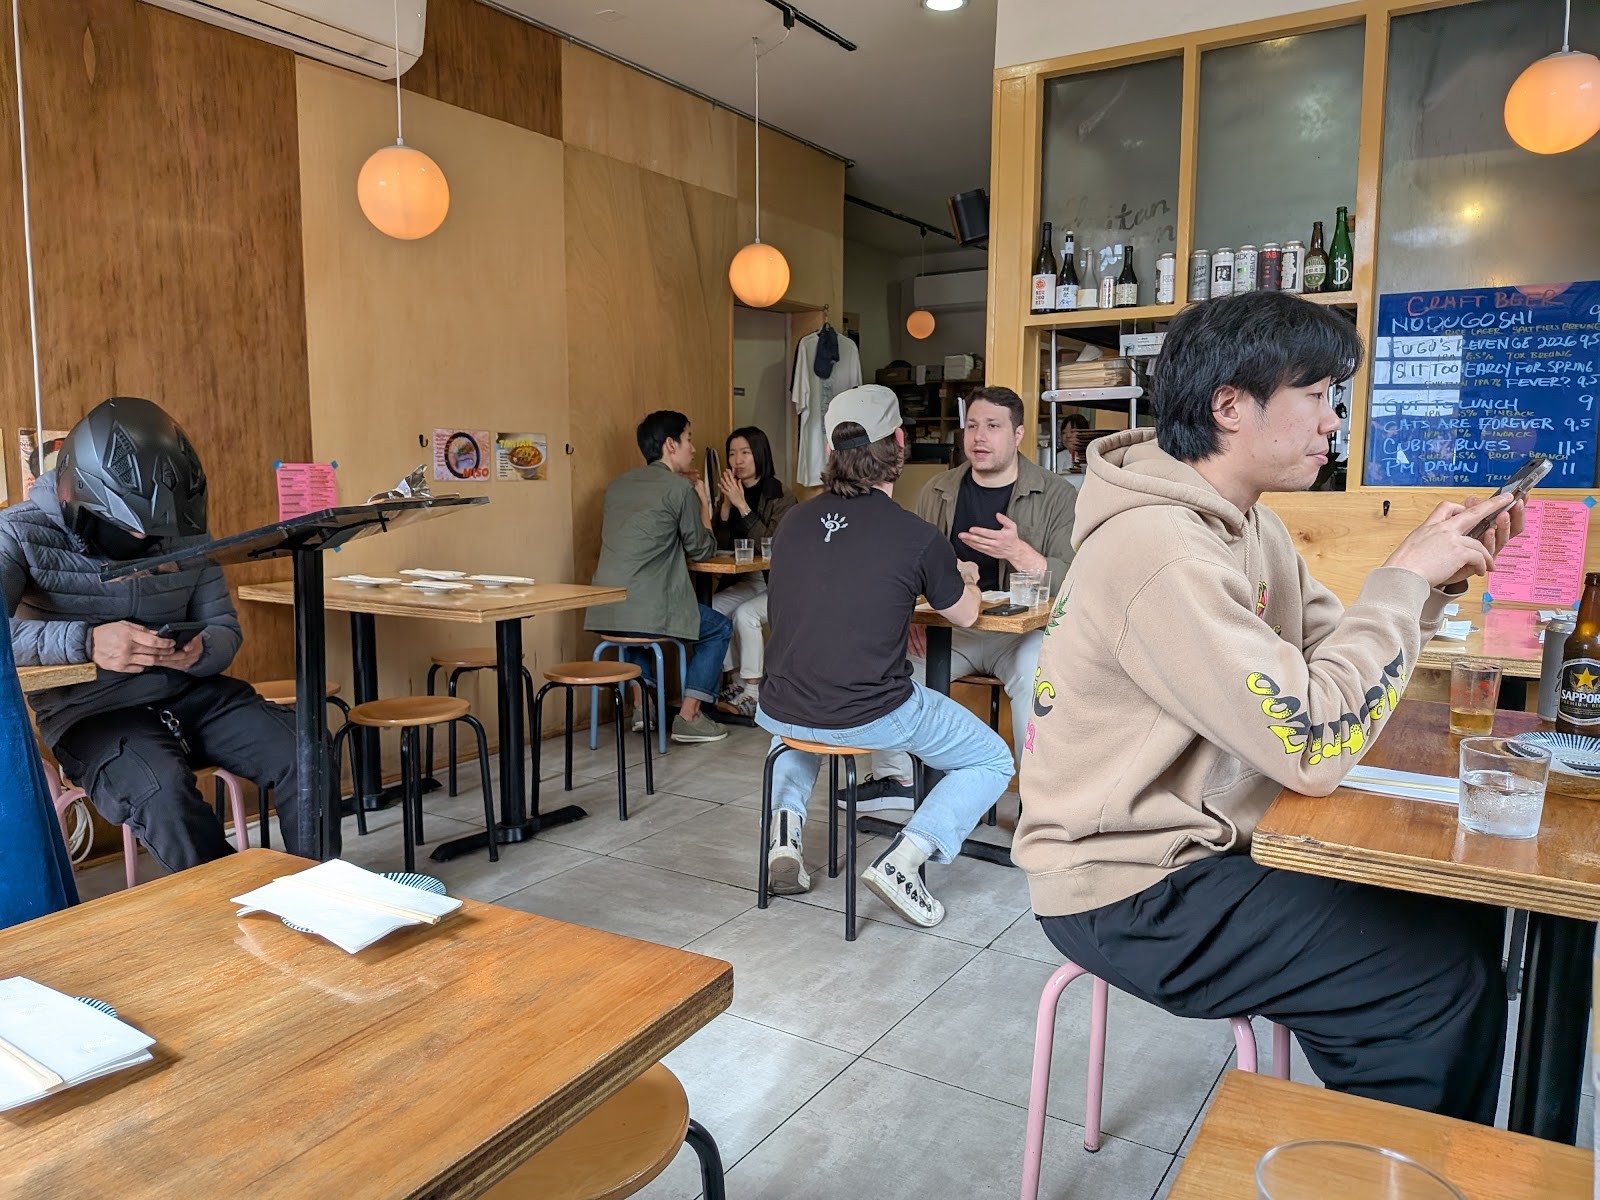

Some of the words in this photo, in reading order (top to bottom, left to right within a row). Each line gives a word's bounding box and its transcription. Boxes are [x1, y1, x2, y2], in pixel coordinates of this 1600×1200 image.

[1495, 289, 1564, 309] BEER
[1471, 327, 1503, 336] LAGER
[1457, 336, 1533, 352] REVENGE
[1537, 335, 1577, 350] 2026
[1430, 362, 1459, 377] TOO
[1464, 361, 1511, 378] EARLY
[1515, 361, 1545, 376] FOR
[1548, 360, 1593, 374] SPRING
[1506, 376, 1571, 389] FEVER?
[1577, 374, 1600, 388] 9.5
[1458, 397, 1518, 411] LUNCH
[1579, 394, 1594, 411] 9
[1485, 409, 1535, 417] FINBACK
[1383, 418, 1430, 433] CATS
[1437, 418, 1471, 429] ARE
[1478, 416, 1554, 431] FOREVER
[1564, 417, 1592, 432] 9.5
[1455, 438, 1511, 452] BLUES
[1558, 440, 1587, 455] 11.5
[1488, 451, 1515, 460] ROOT
[1528, 450, 1568, 461] BRANCH
[463, 467, 490, 478] MISO
[1380, 457, 1415, 477] PM
[1424, 461, 1479, 474] DAWN
[1561, 462, 1575, 476] 11
